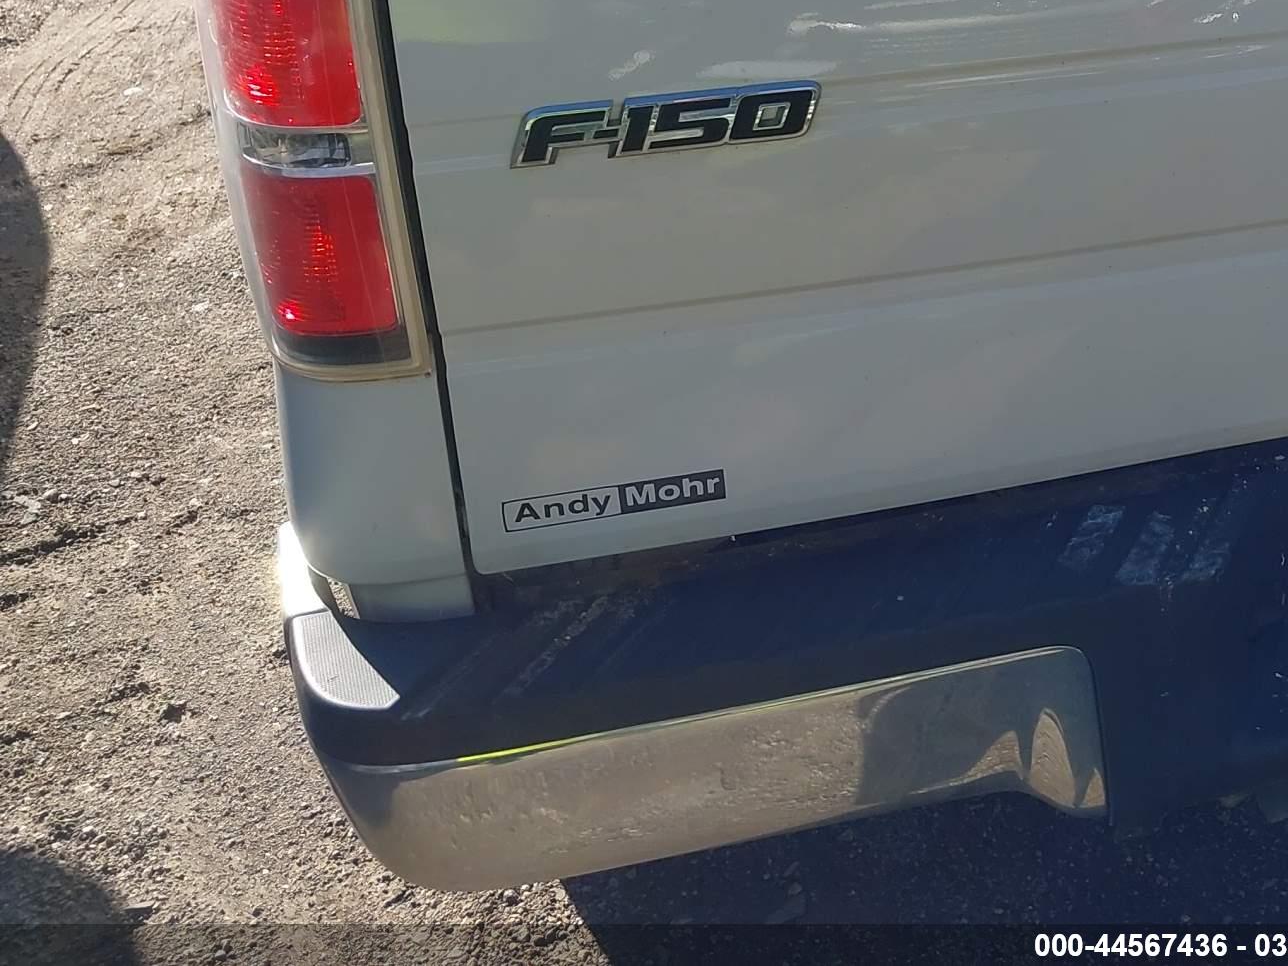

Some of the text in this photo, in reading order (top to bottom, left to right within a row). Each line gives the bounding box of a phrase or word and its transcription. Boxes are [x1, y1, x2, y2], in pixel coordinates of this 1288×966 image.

[510, 79, 822, 169] F-150
[514, 475, 721, 523] Andy Mohr
